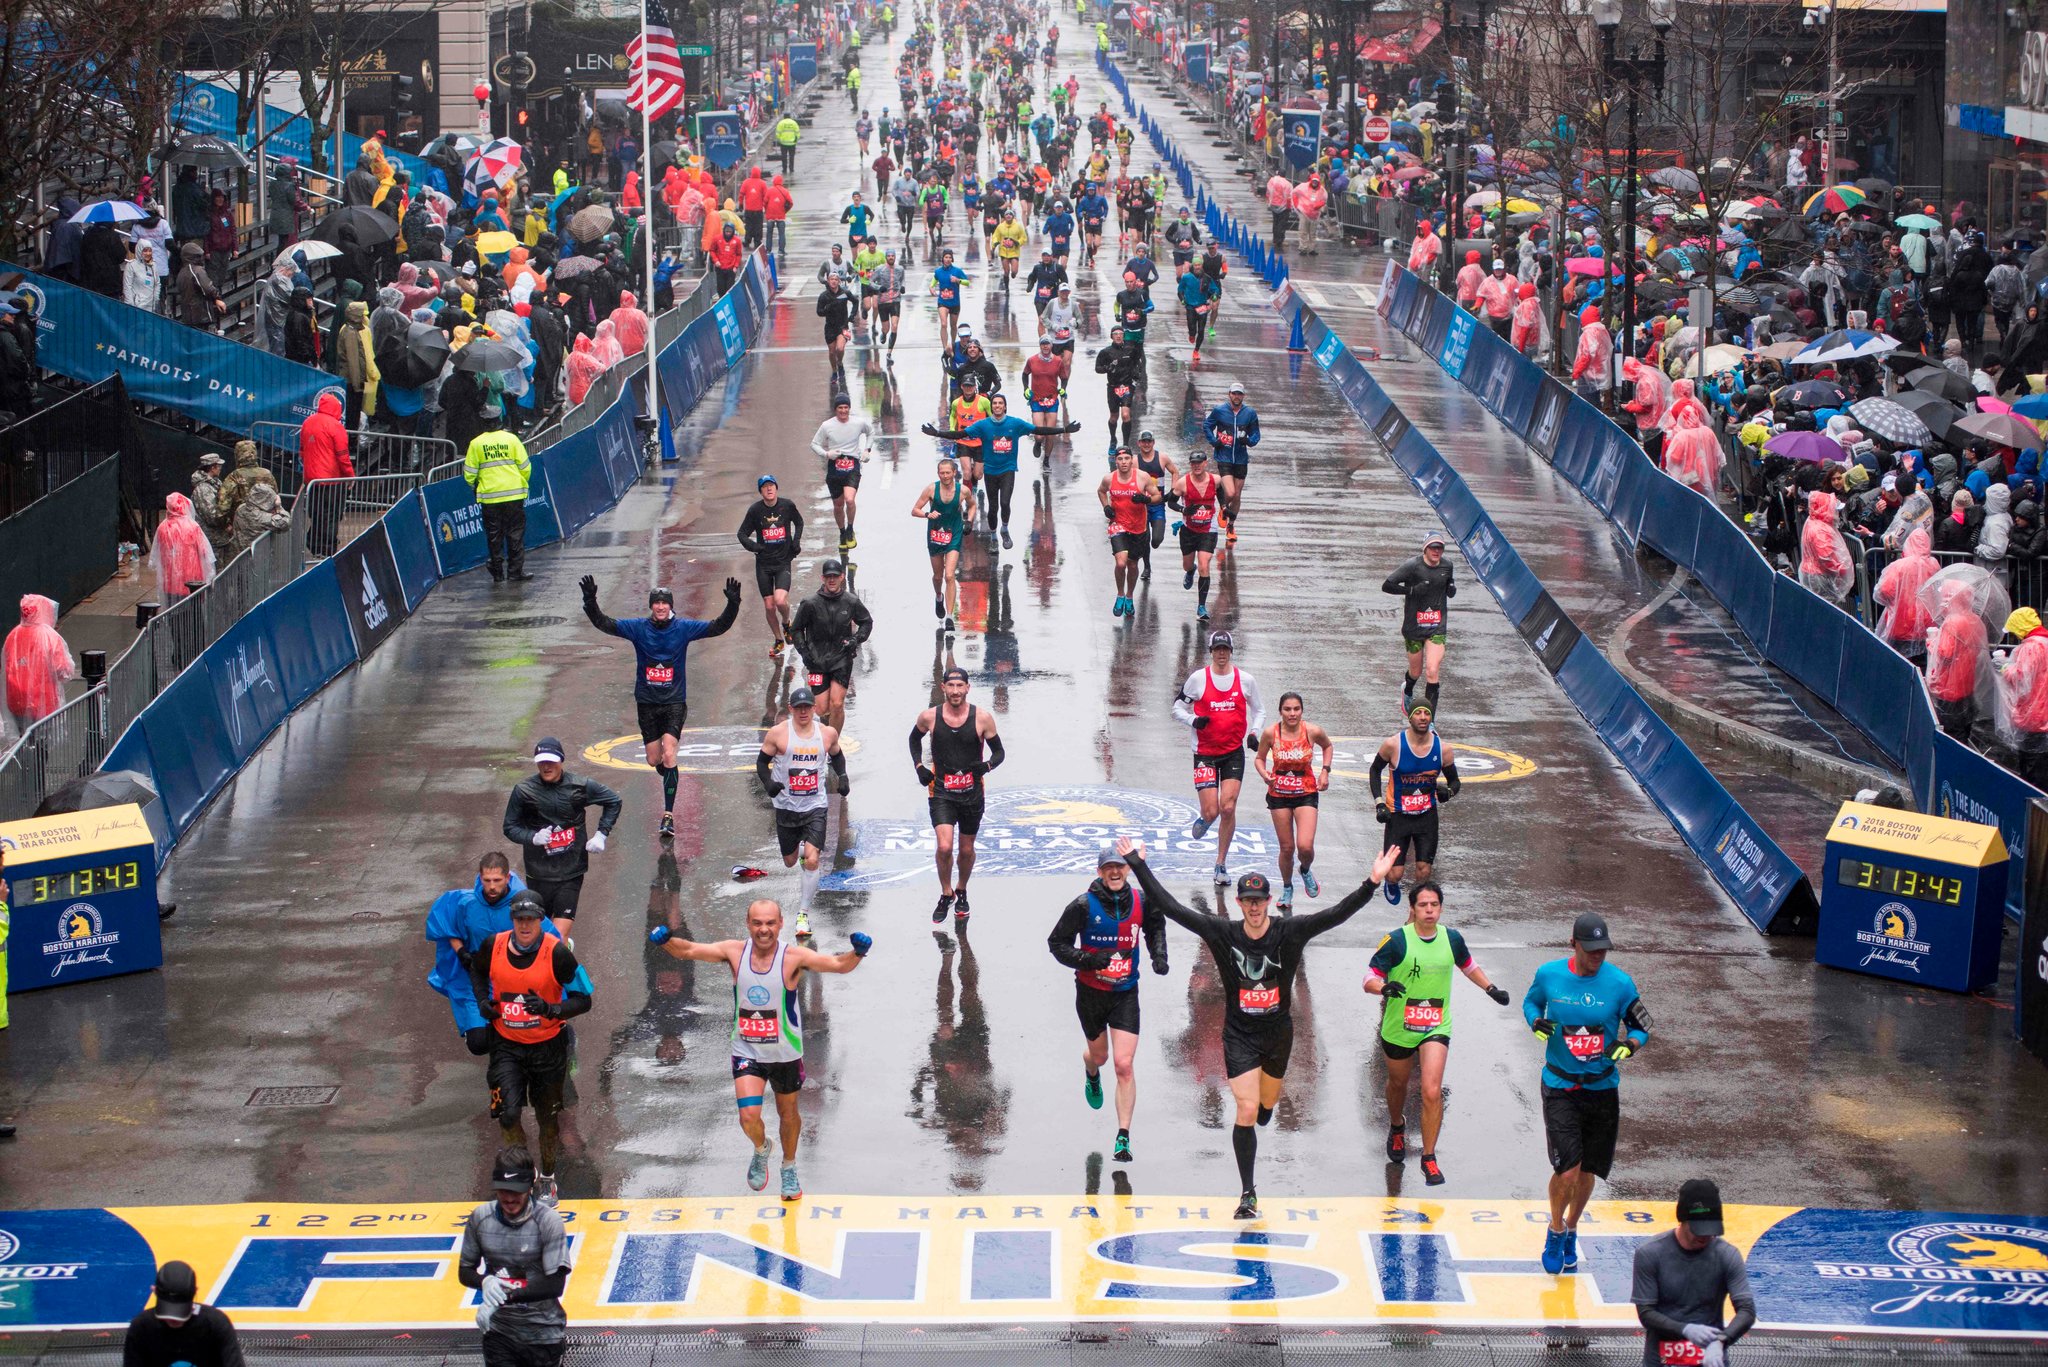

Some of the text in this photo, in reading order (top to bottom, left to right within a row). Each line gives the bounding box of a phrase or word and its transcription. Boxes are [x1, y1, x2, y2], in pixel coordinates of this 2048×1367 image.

[682, 47, 702, 55] EXETER
[208, 378, 247, 399] DAY
[292, 404, 317, 417] BOSTO
[483, 443, 509, 452] Boston
[484, 450, 510, 460] Police
[452, 507, 469, 523] THE
[764, 527, 784, 537] 3809
[932, 531, 950, 540] 5196
[364, 599, 389, 630] adidas
[1418, 612, 1438, 621] 3068
[648, 668, 672, 677] 6318
[792, 754, 817, 762] REAM
[792, 775, 817, 785] 3628
[947, 774, 972, 785] 3442
[1277, 775, 1302, 786] 6625
[1954, 789, 2000, 829] THE BOSTON
[1864, 816, 1923, 833] 2018 BOSTON
[18, 825, 77, 842] 2018 BOSTON
[550, 831, 573, 843] 418
[886, 825, 1263, 843] 208 BOSTON
[1860, 825, 1919, 841] MARATHON
[20, 833, 81, 850] MARATHON
[1735, 828, 1765, 867] THE BOSTON
[1722, 845, 1754, 885] MARATHON
[33, 862, 140, 902] 3:13:43
[1858, 863, 1962, 903] 3:13:43
[43, 934, 119, 954] BOSTON MARATHON
[1856, 932, 1931, 953] BOSTON MARATHON
[1108, 961, 1129, 972] 604
[1243, 989, 1277, 1002] 4597
[1408, 1007, 1440, 1020] 3506
[742, 1019, 774, 1033] 2133
[1565, 1036, 1600, 1050] 5479
[898, 1204, 1319, 1222] MARATHN
[1912, 1223, 2008, 1244] ATHLETIC
[212, 1231, 1652, 1311] FNISH
[1815, 1265, 1976, 1282] BOSTON
